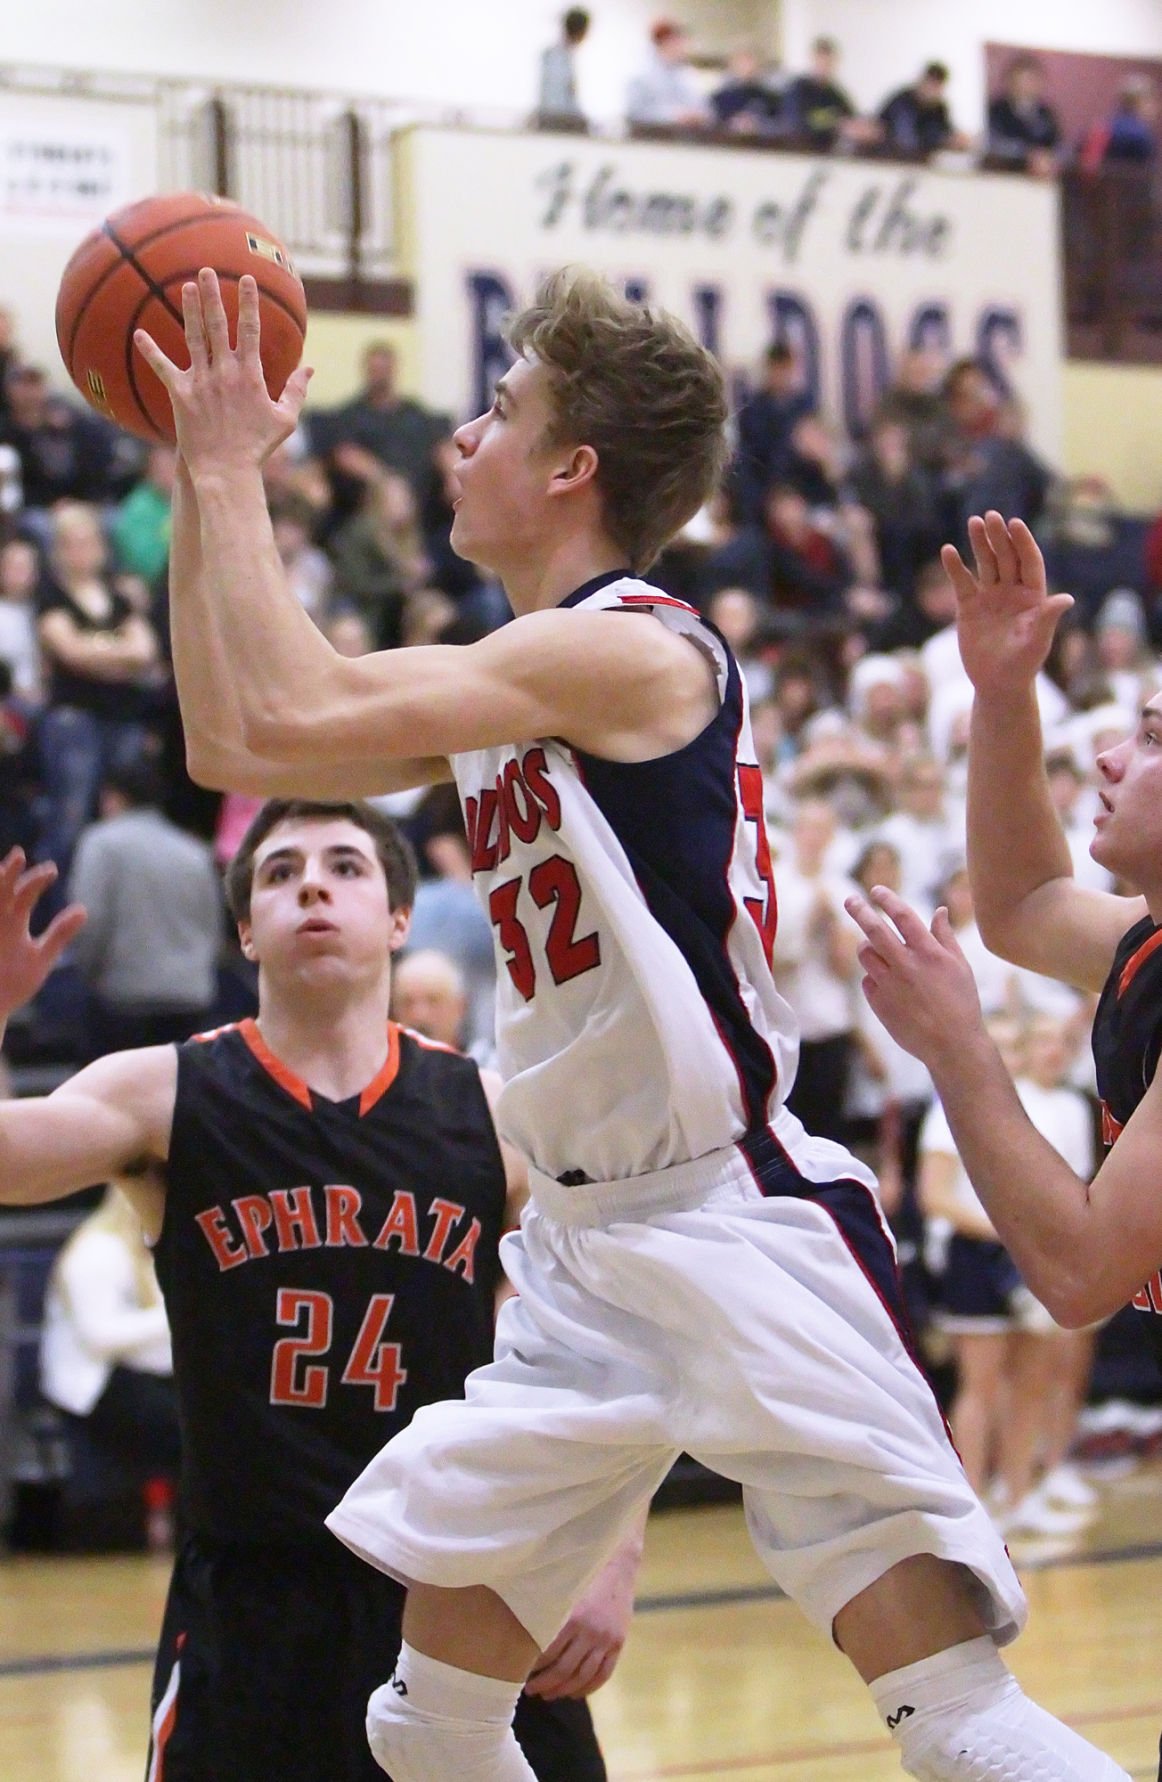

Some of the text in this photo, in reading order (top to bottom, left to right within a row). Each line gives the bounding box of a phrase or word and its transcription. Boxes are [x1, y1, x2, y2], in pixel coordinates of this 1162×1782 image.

[535, 161, 951, 264] Home of the
[489, 853, 601, 1002] 32
[194, 1184, 482, 1285] EPHRATA
[269, 1287, 407, 1412] 24
